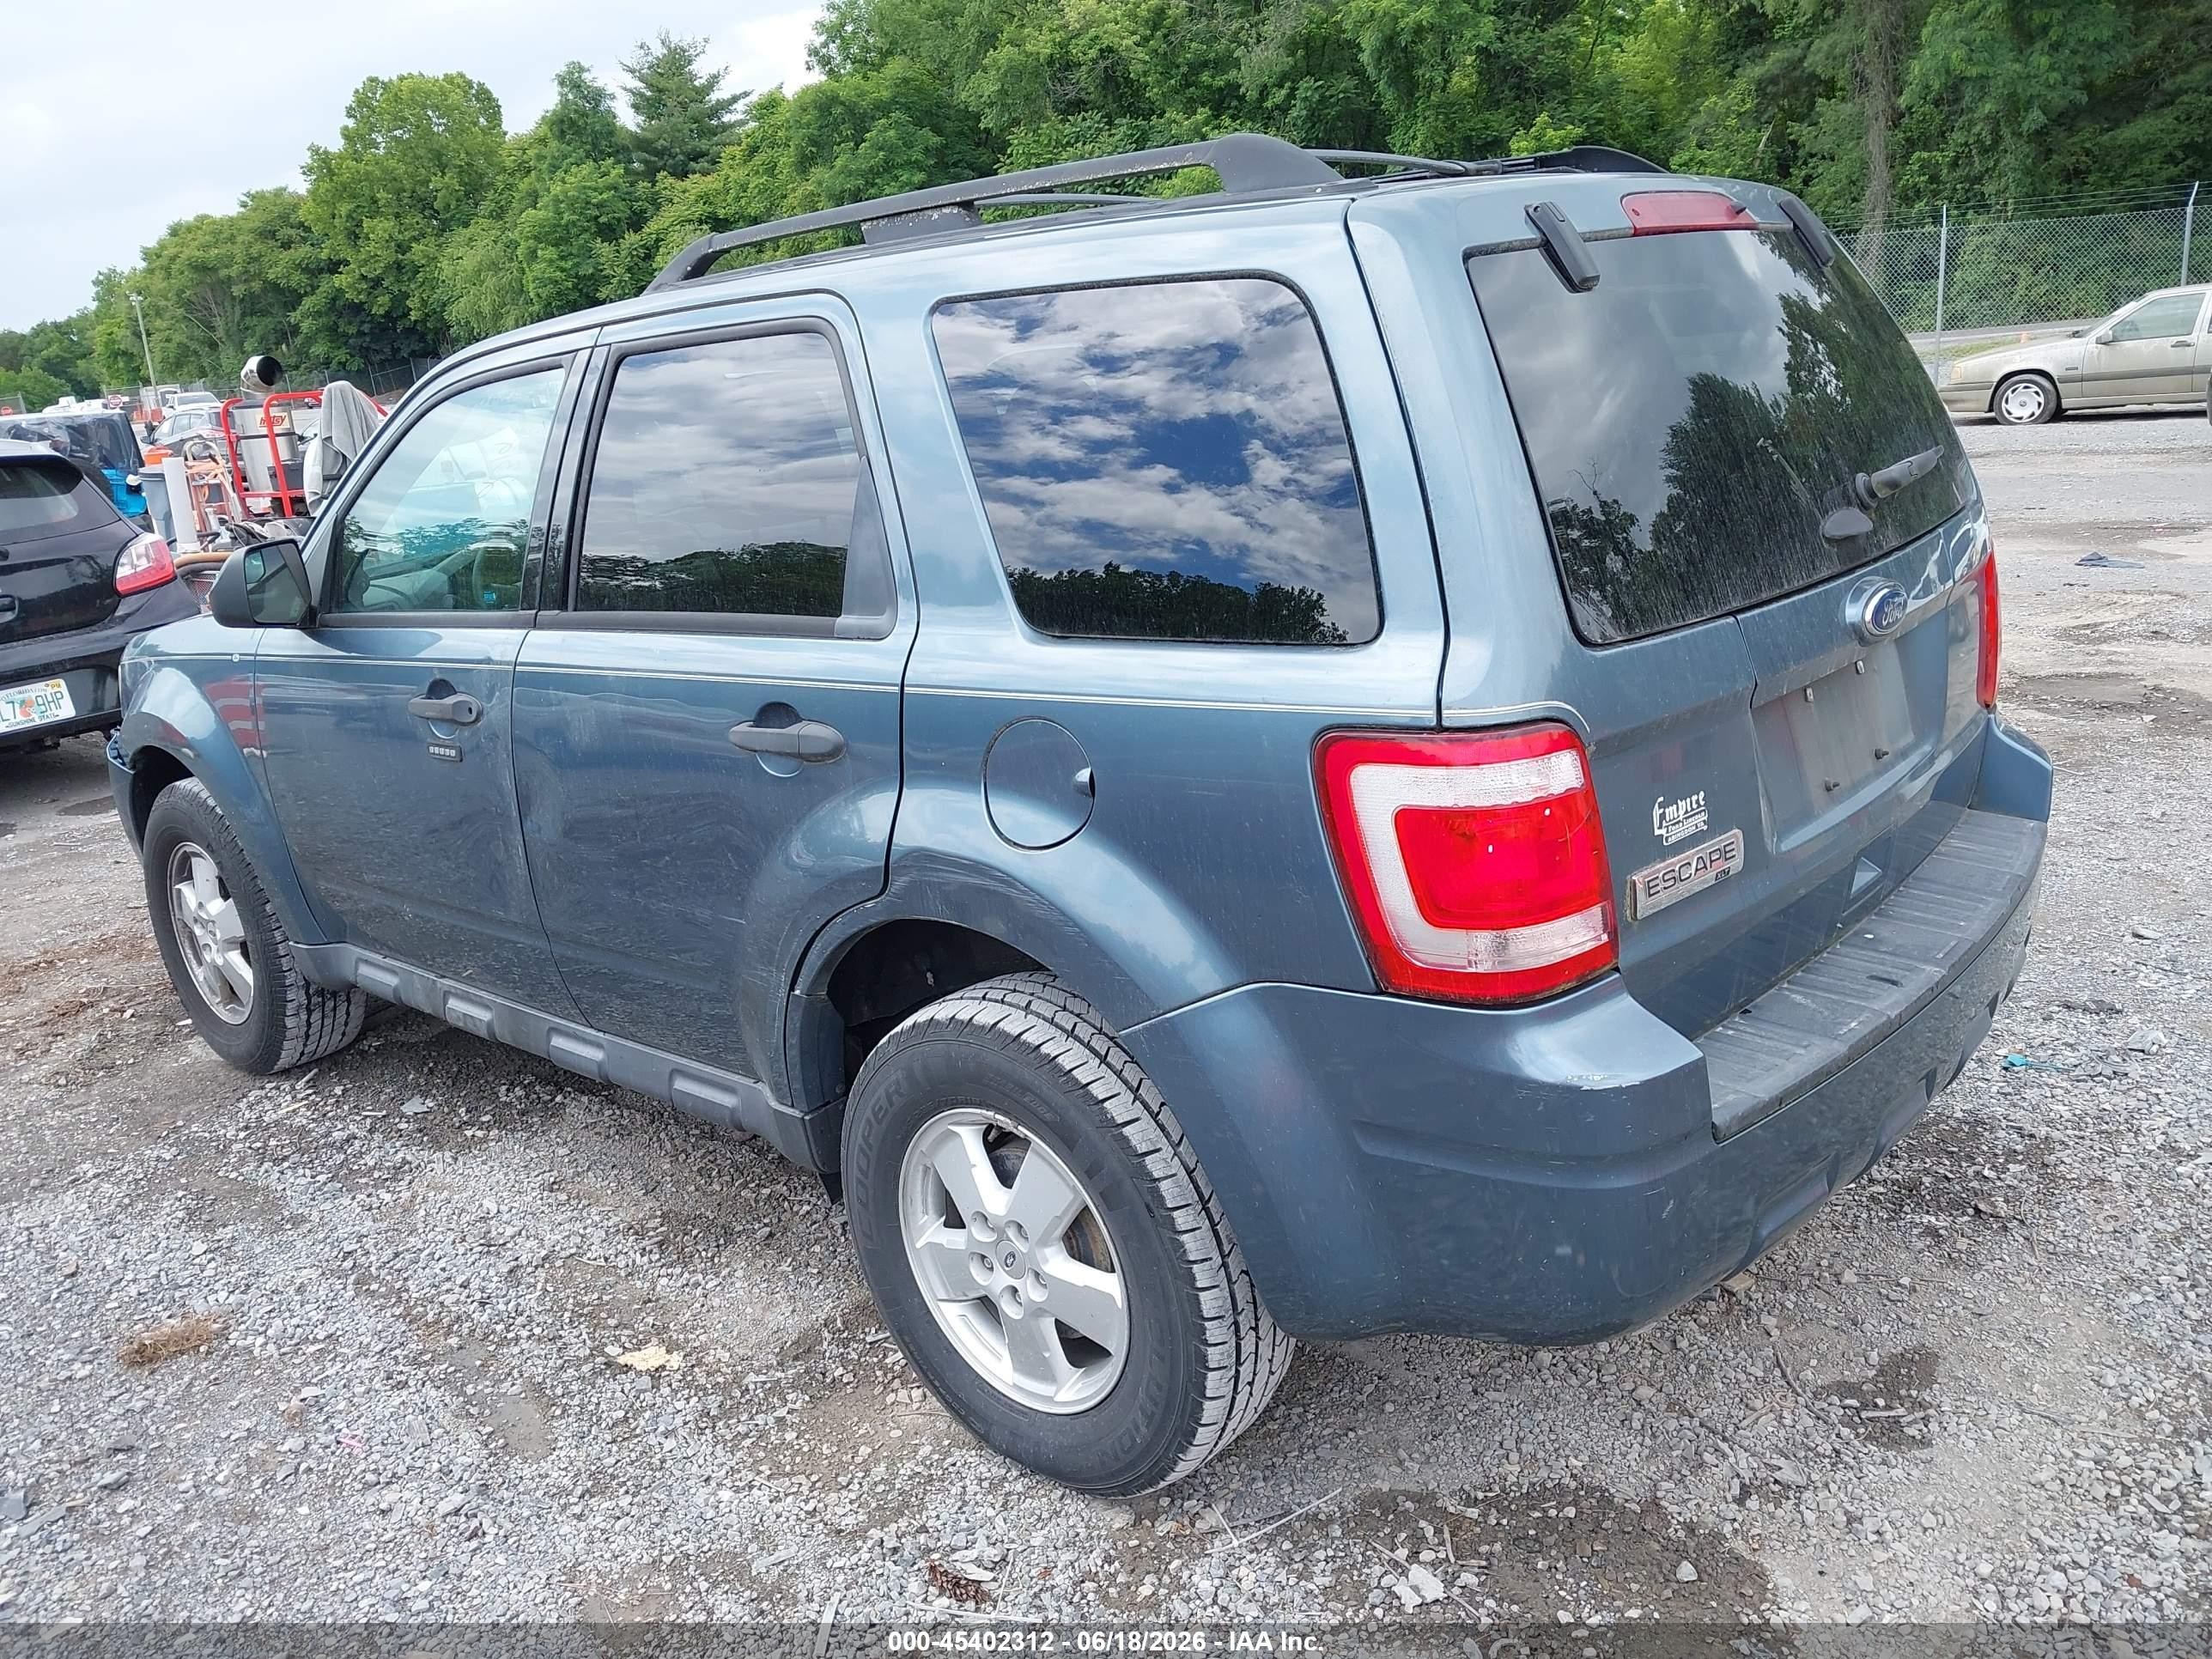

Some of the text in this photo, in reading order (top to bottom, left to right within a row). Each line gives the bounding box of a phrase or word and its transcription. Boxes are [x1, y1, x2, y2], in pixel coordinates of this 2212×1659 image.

[259, 415, 287, 428] htsy
[35, 690, 64, 714] 9HP
[1653, 790, 1705, 836] Empire
[1645, 839, 1737, 899] ESCAPE
[1716, 867, 1730, 880] XLT
[856, 1077, 906, 1243] COOPER
